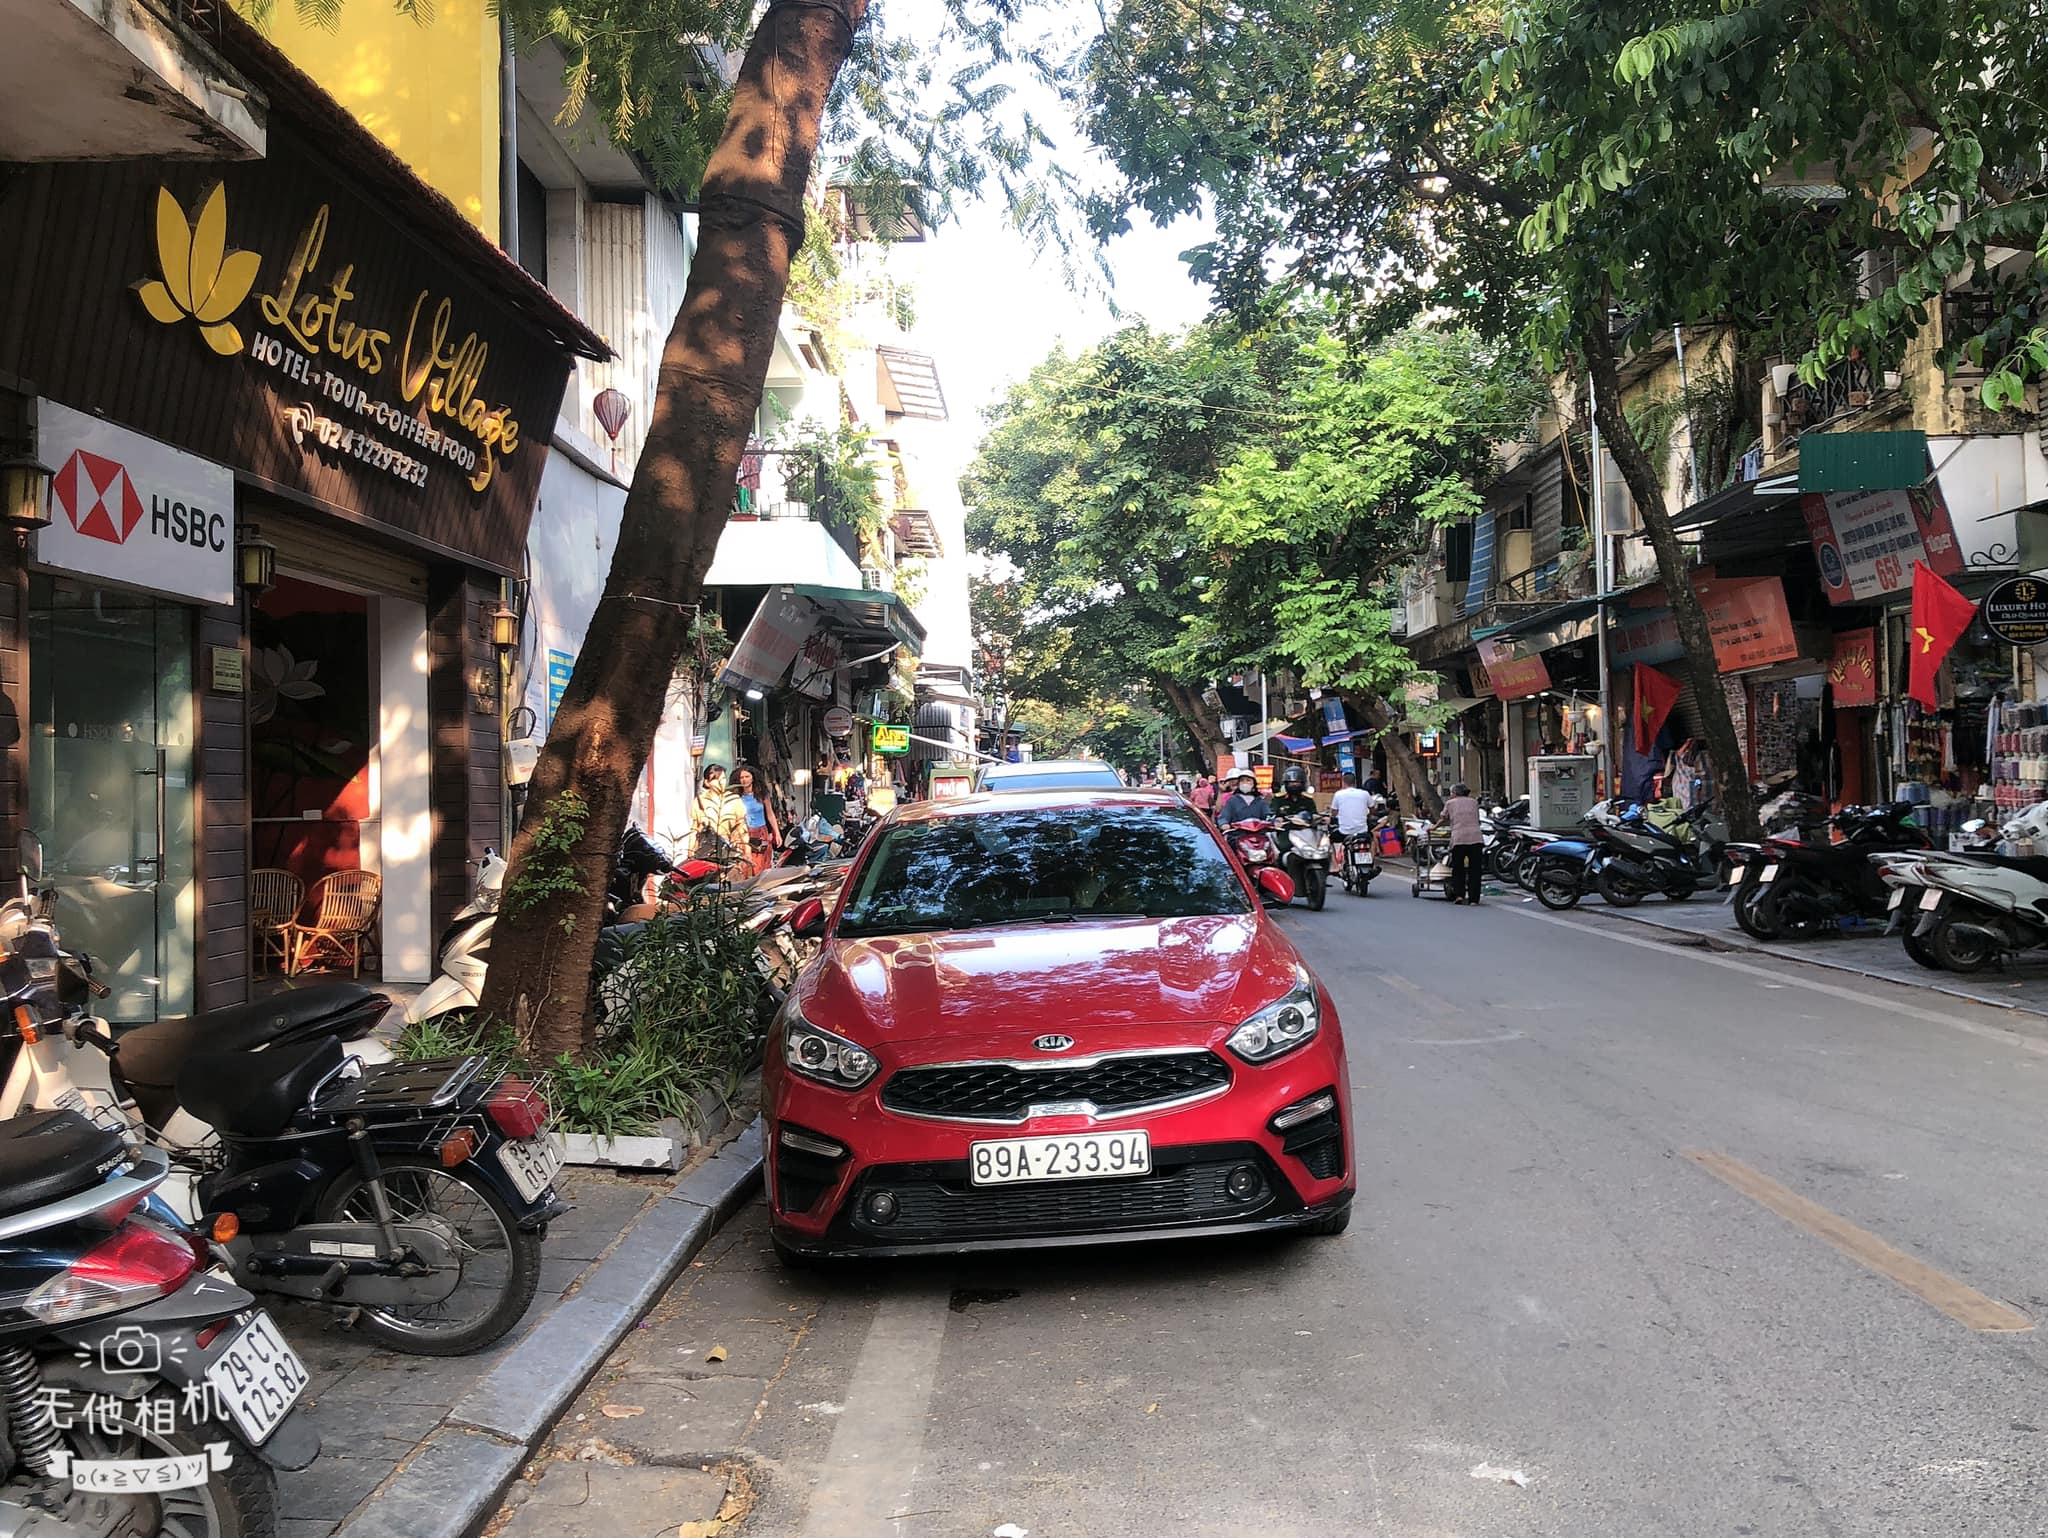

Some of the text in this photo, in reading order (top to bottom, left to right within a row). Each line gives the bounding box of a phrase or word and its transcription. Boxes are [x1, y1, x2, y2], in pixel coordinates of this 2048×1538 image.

[261, 203, 520, 492] Lotus Village
[251, 331, 310, 386] HOTEL
[322, 371, 368, 416] TOUR
[440, 436, 476, 471] FOOD
[152, 494, 225, 552] HSBC
[1990, 603, 2028, 612] LUXURY
[1038, 1036, 1069, 1048] KIA
[976, 1137, 1145, 1179] 89A-233.94
[242, 1352, 306, 1432] 125.82
